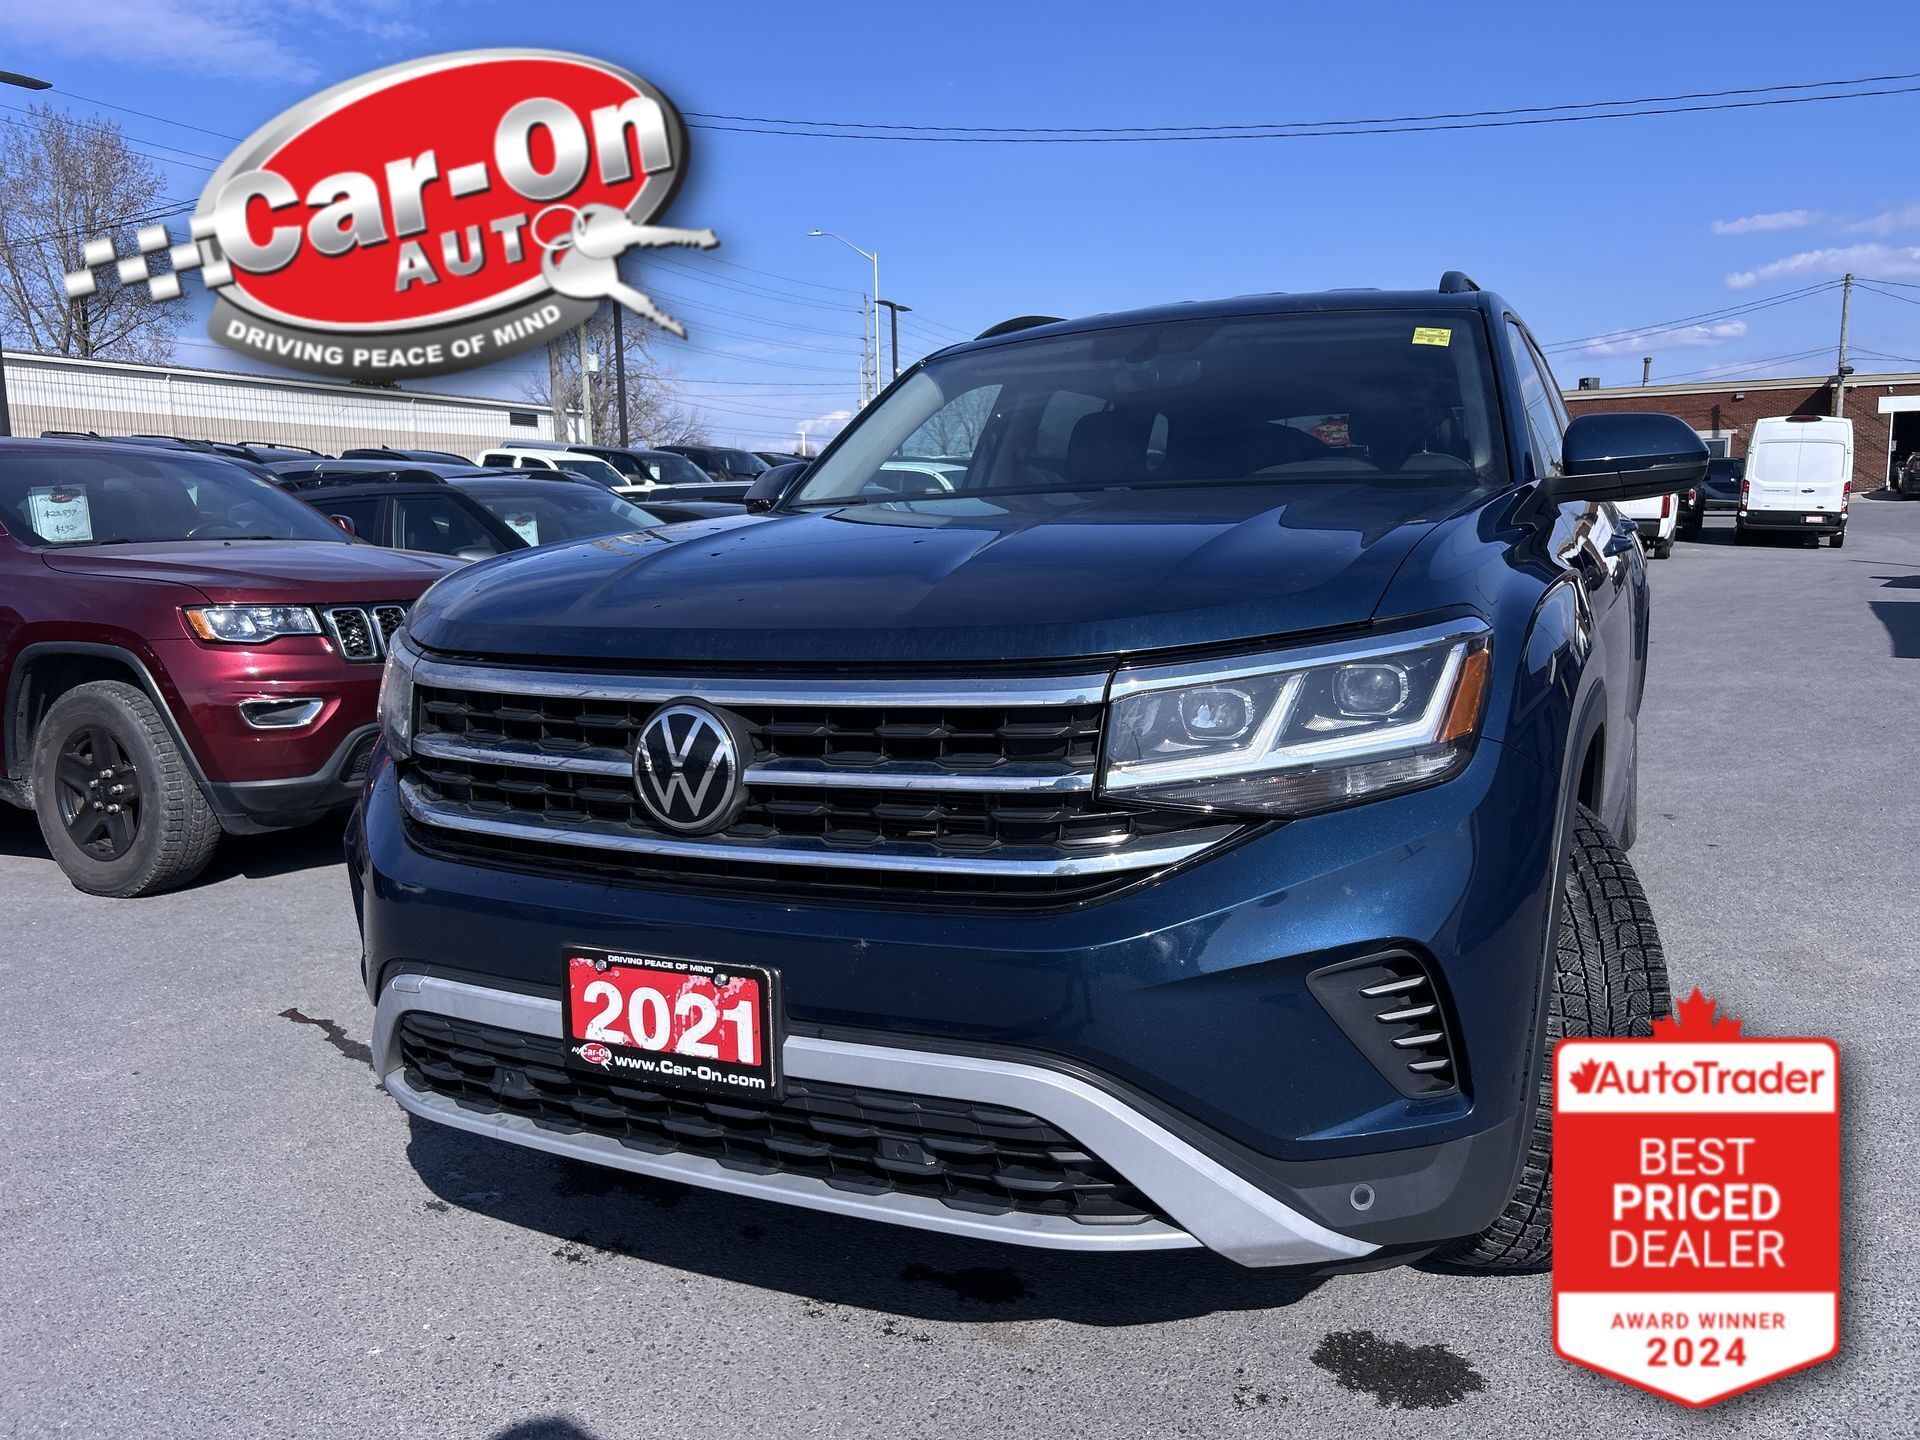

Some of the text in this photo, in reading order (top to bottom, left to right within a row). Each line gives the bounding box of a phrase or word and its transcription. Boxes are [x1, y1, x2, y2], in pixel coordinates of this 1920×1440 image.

[608, 954, 714, 974] DRIVING PEACE OF MIND
[583, 980, 755, 1064] 2021
[614, 1055, 766, 1090] www.Car-On.com
